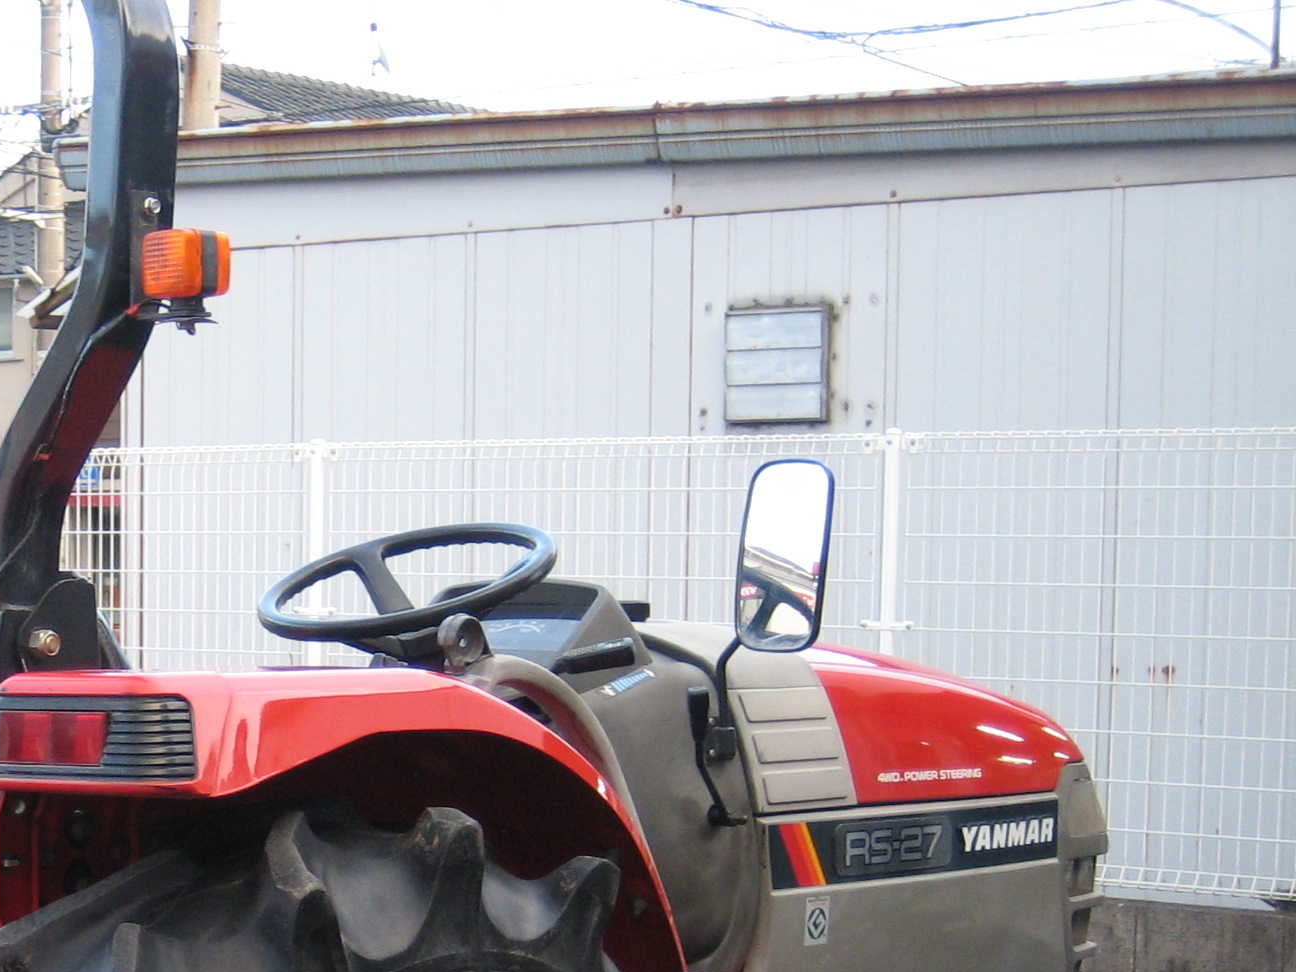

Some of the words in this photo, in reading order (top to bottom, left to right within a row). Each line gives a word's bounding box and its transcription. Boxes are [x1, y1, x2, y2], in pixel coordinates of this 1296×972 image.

[904, 770, 939, 781] POWER
[940, 768, 982, 780] STEERING
[845, 825, 943, 867] RS-27
[961, 817, 1054, 853] YANMAR
